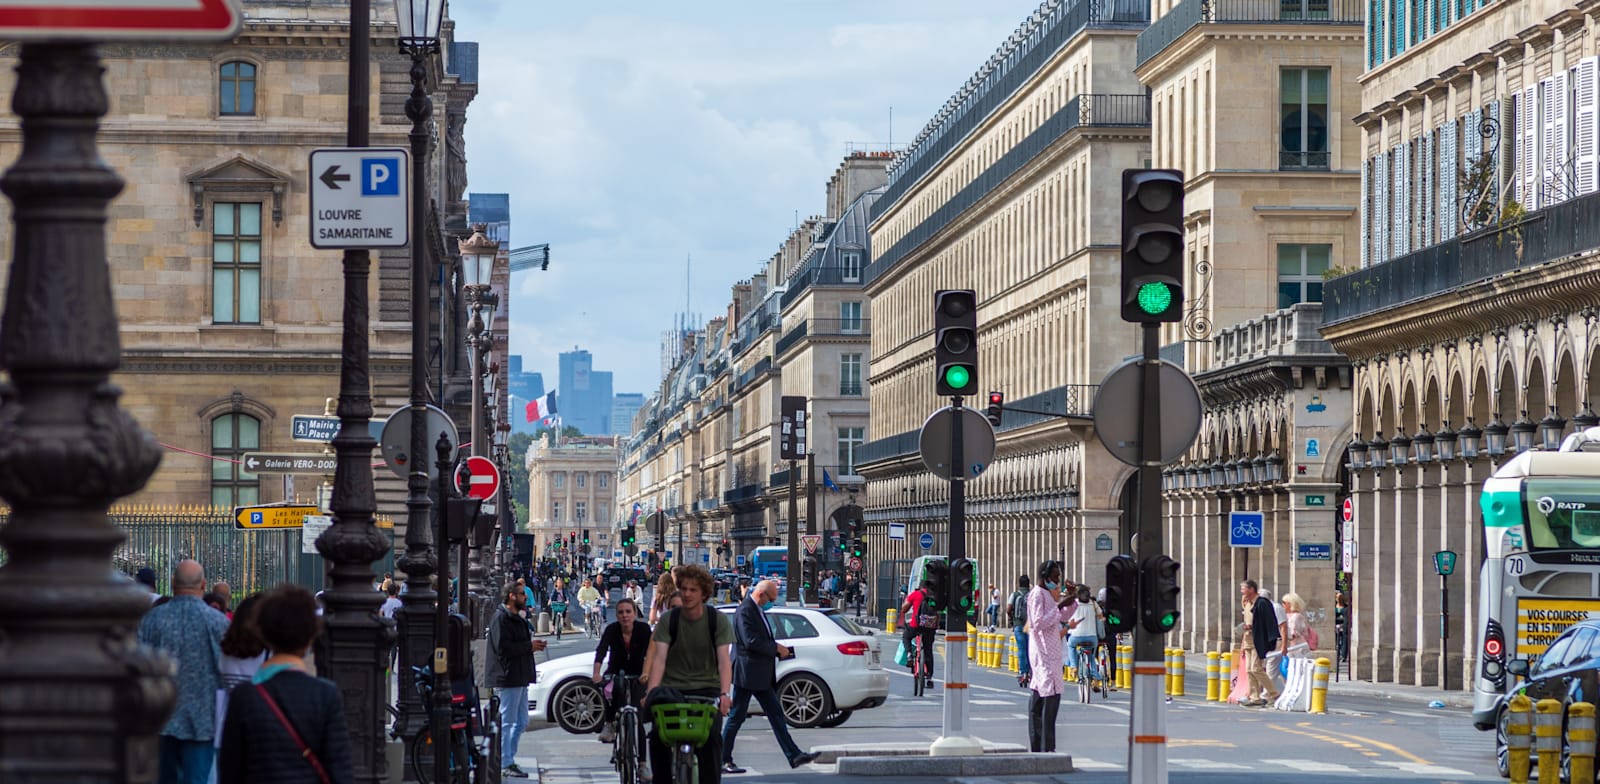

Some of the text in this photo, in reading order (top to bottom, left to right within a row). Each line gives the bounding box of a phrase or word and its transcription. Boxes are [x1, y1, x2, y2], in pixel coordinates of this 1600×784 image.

[370, 163, 390, 191] P
[318, 209, 362, 220] LOUVRE
[319, 228, 393, 239] SAMARITAINE
[308, 419, 334, 430] Mairie
[308, 429, 330, 439] Place
[264, 459, 291, 469] Galerie
[1557, 502, 1586, 510] RATP
[253, 513, 261, 523] P
[1509, 558, 1523, 574] 70
[1527, 610, 1589, 621] VOS COURSES
[1527, 622, 1539, 633] EN
[1541, 623, 1551, 633] 15
